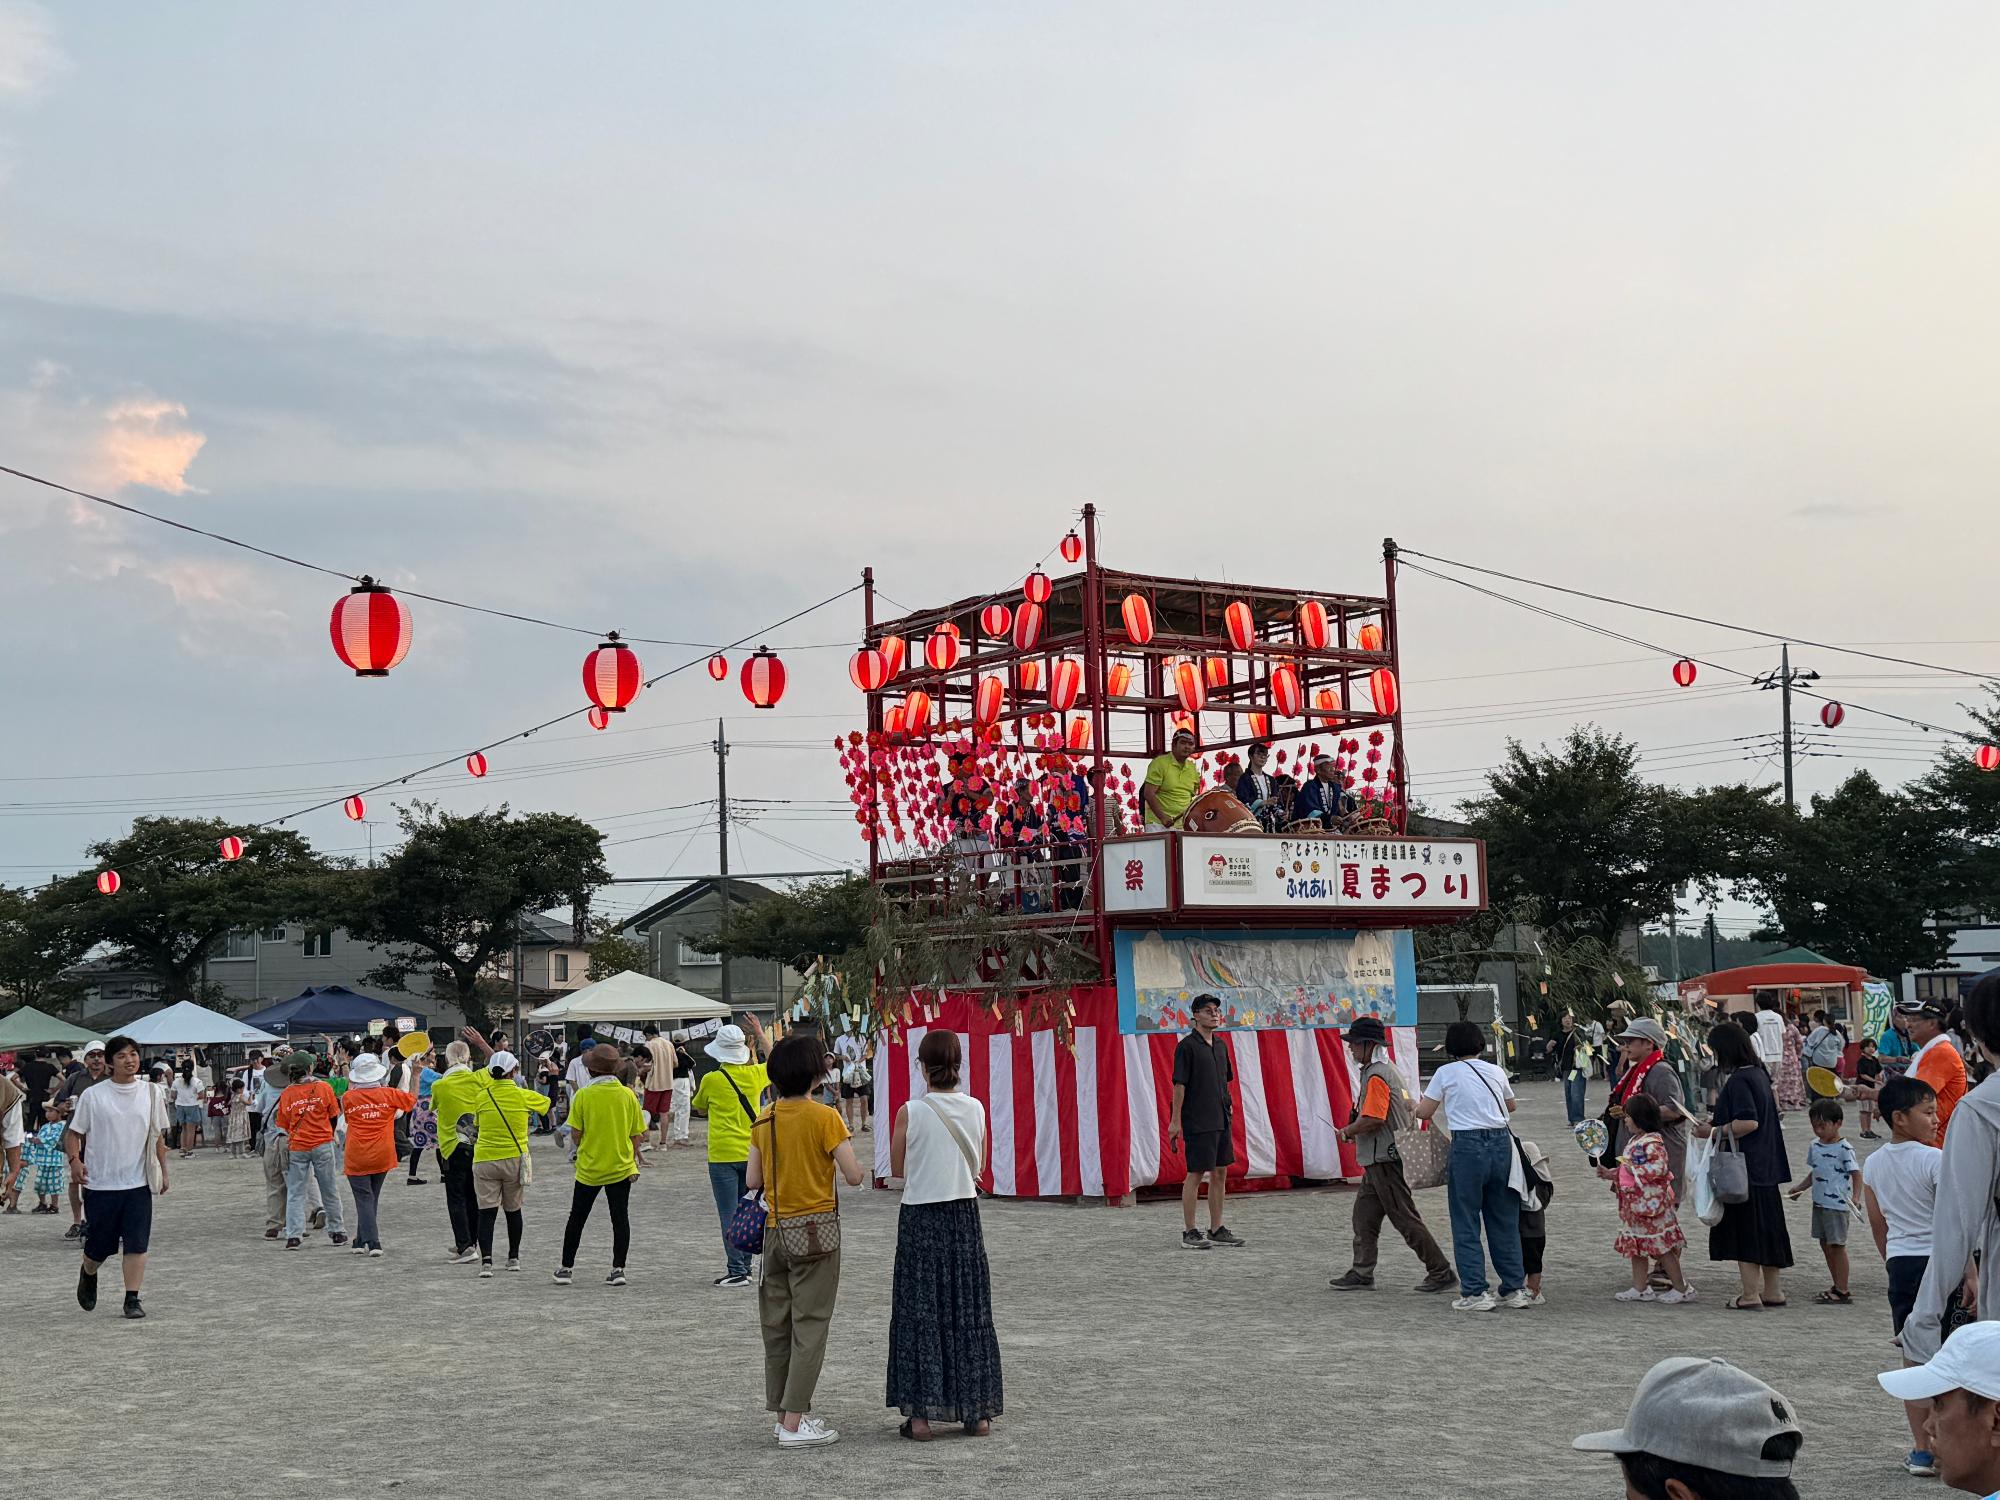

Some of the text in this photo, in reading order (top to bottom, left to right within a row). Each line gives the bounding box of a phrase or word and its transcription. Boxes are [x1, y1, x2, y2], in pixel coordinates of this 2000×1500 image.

[1125, 860, 1143, 891] 祭
[1287, 864, 1468, 900] ふれあい 夏まつり
